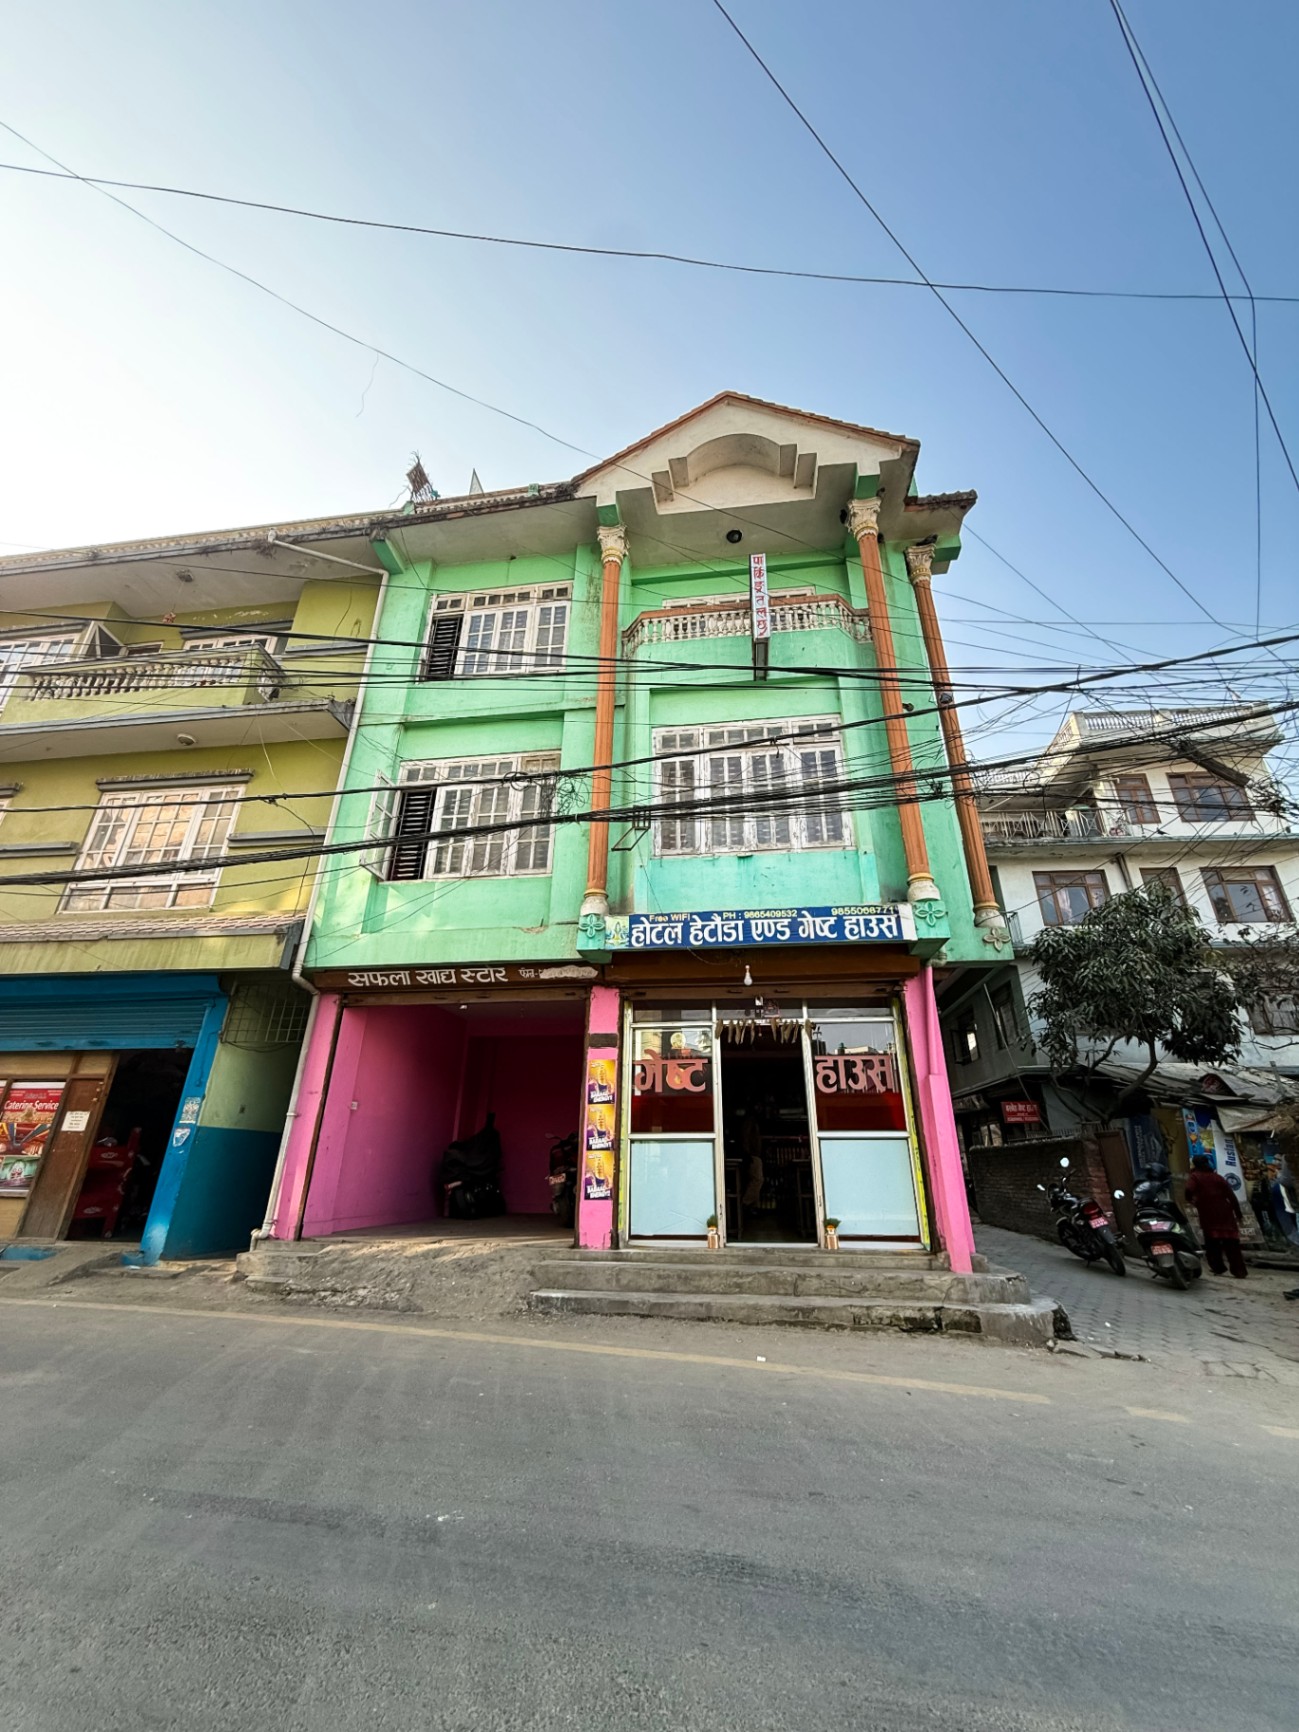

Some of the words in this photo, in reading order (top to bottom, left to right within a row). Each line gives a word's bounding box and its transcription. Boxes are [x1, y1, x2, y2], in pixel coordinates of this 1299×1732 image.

[671, 913, 690, 921] WIFI
[631, 917, 683, 946] होटल
[689, 913, 744, 945] हेटौडा
[750, 918, 791, 941] एण्ड
[798, 911, 838, 939] गेष्ट
[843, 914, 898, 940] हाउस
[348, 970, 411, 987] सफला
[415, 968, 457, 985] खाद्य
[460, 966, 509, 983] स्टोर
[633, 1048, 708, 1093] गेष्ट
[814, 1055, 893, 1094] हाउस
[34, 1100, 60, 1111] Service
